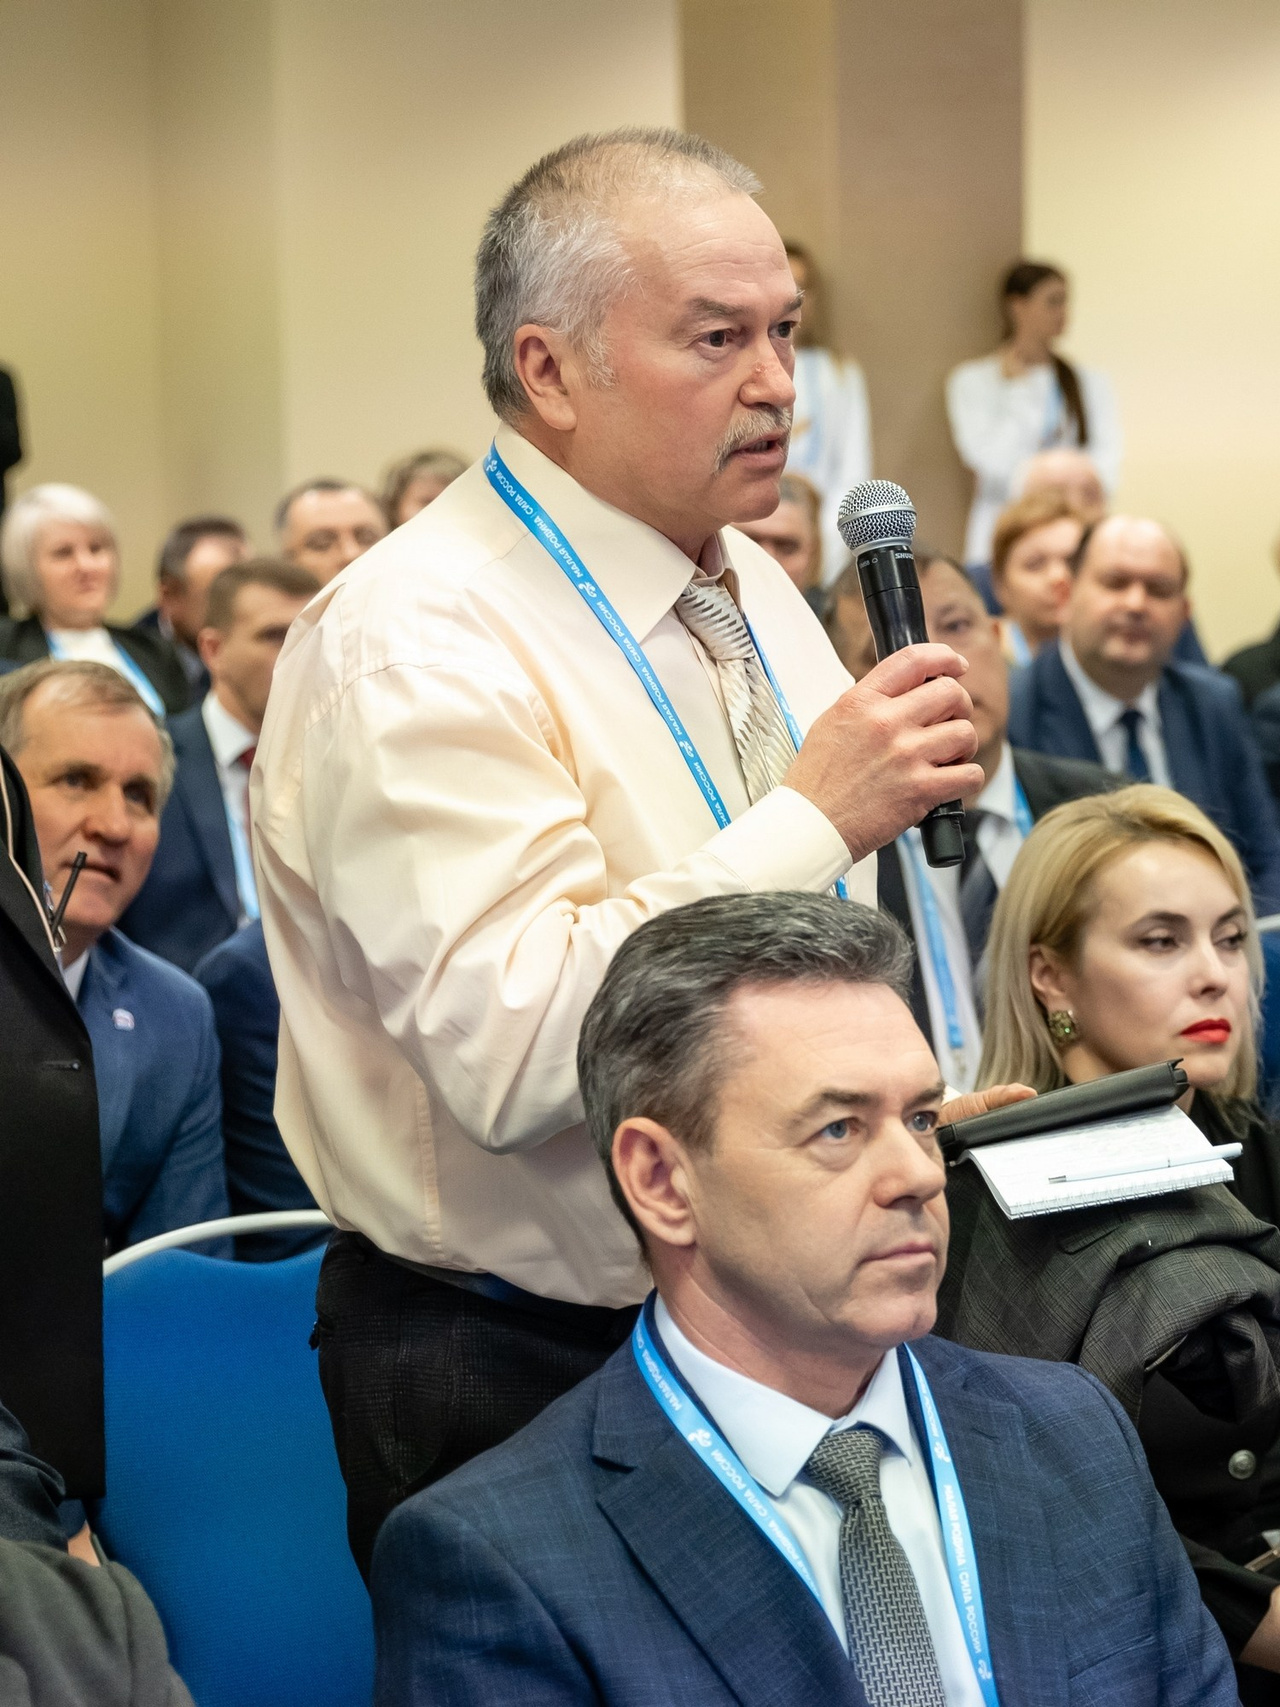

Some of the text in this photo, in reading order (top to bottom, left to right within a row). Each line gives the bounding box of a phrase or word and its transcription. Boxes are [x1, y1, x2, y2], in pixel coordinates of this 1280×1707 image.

[495, 470, 583, 578] МАЛАЯ РОДИНА СИЛА РОССИИ
[596, 600, 683, 736] МАЛАЯ РОДИНА СИЛА РОССИИ
[693, 761, 717, 801] РОССИИ
[710, 1449, 747, 1490] РОССИИ
[743, 1488, 768, 1518] СИЛА
[958, 1571, 973, 1604] СИЛА
[965, 1605, 982, 1654] РОССИИ
